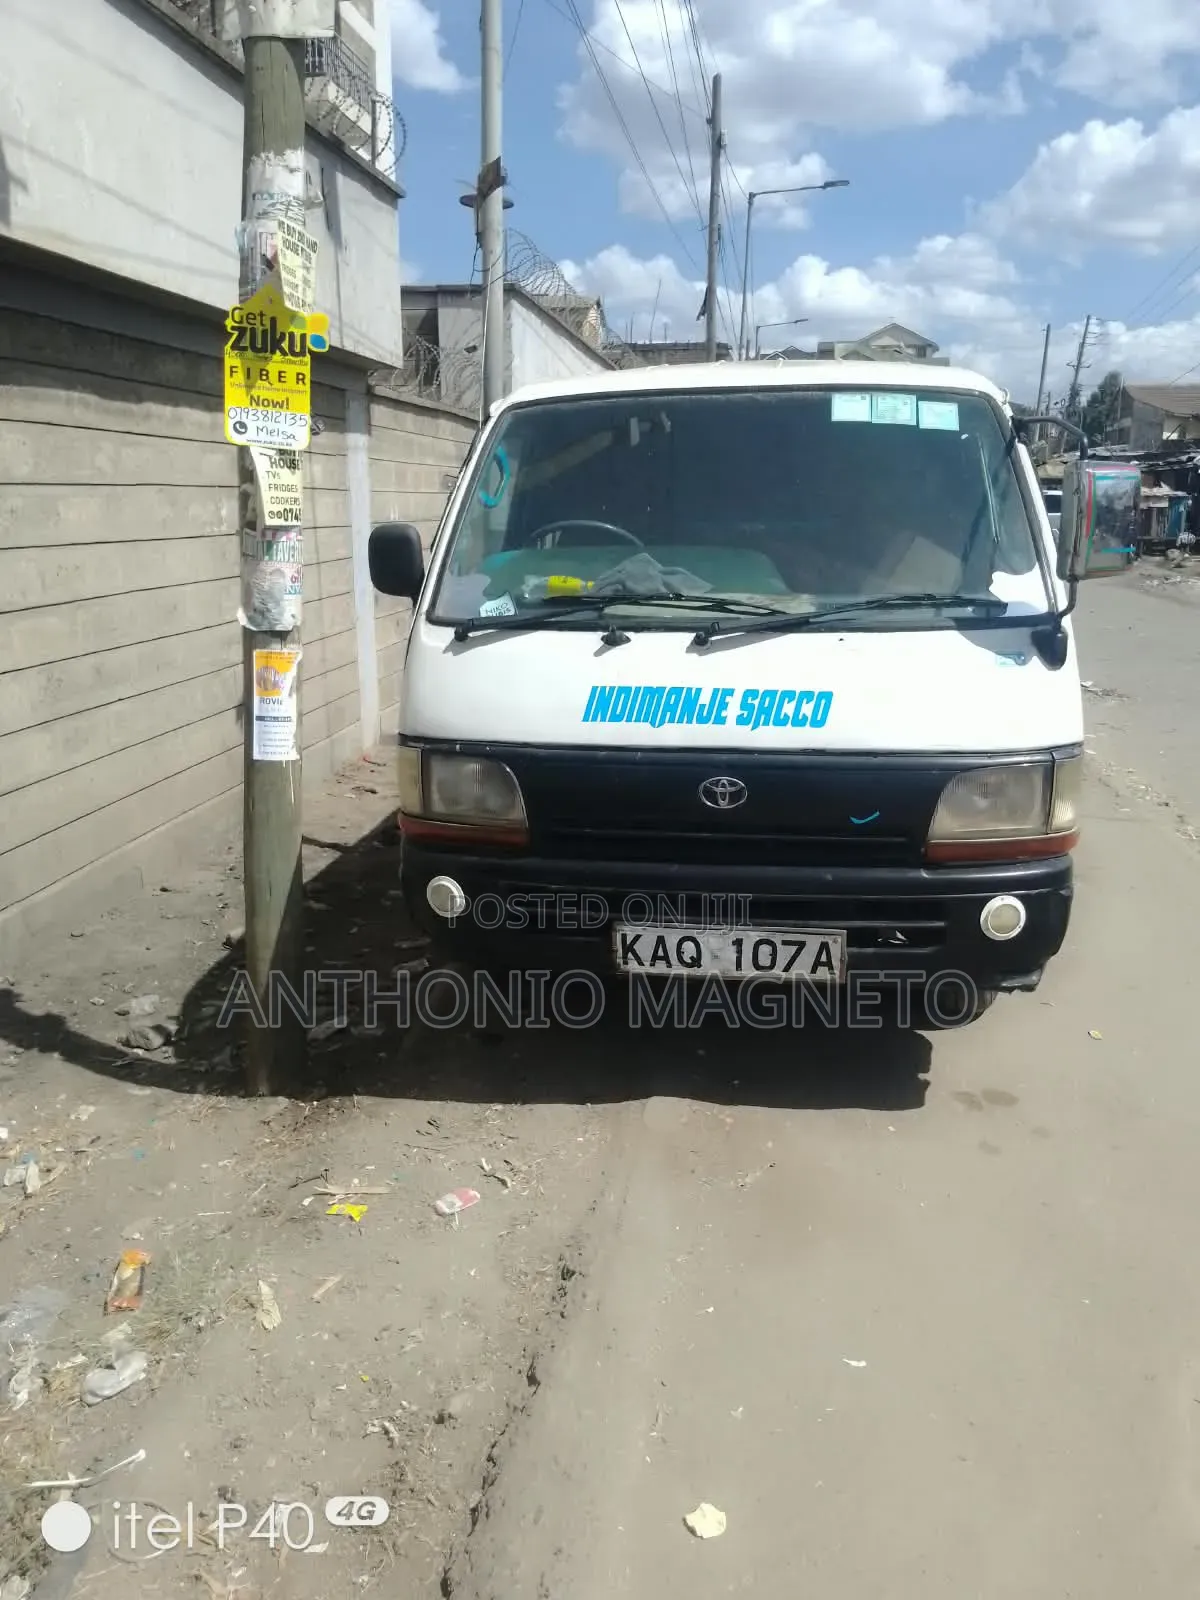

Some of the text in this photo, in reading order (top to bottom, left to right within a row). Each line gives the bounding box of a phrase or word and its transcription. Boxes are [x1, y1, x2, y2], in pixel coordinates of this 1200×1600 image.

[231, 307, 267, 327] Get
[226, 316, 307, 358] zuku
[229, 365, 307, 386] FIBER
[250, 395, 290, 410] Now!
[265, 470, 281, 480] TVs
[268, 483, 298, 493] FRIDGES
[270, 496, 301, 506] COOKERS
[581, 686, 834, 731] INDIMANJE SACCO
[619, 933, 836, 975] KAQ 107A
